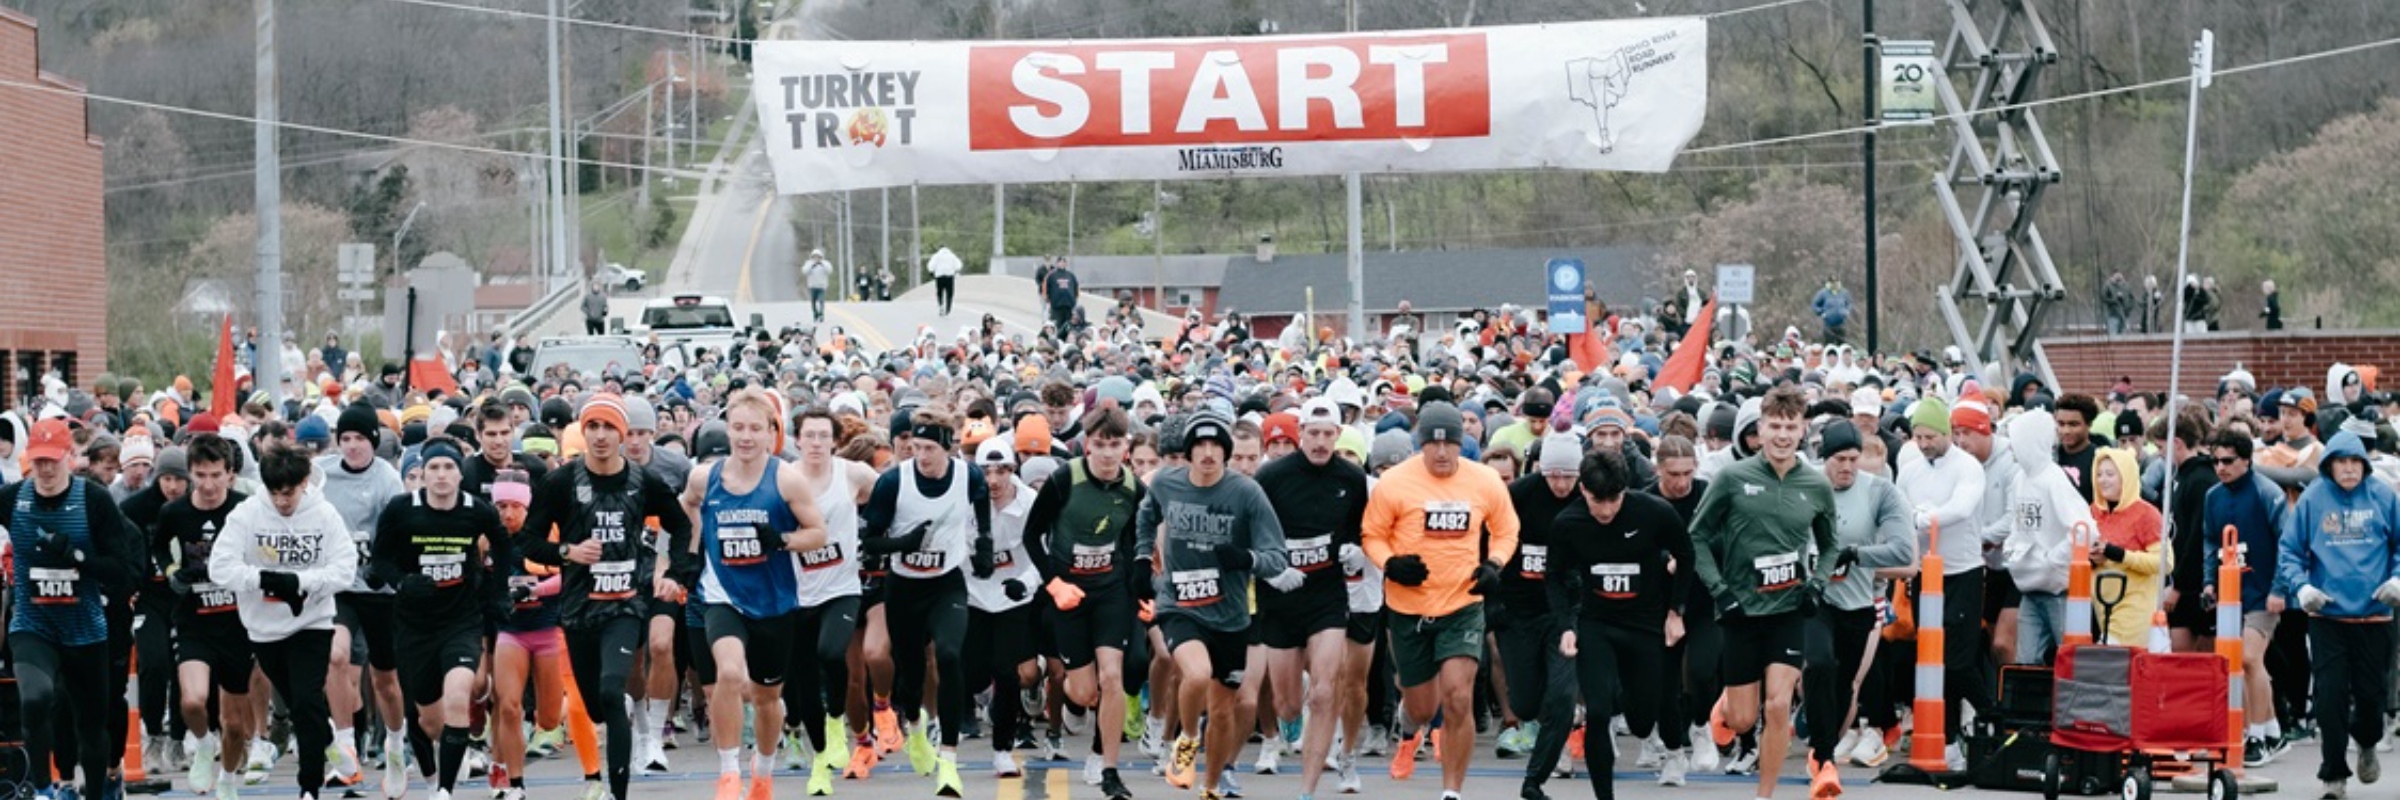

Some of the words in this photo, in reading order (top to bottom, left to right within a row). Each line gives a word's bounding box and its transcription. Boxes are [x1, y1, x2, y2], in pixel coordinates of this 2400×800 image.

[1893, 63, 1924, 82] 20
[780, 71, 921, 110] TURKEY
[1008, 44, 1448, 139] START
[595, 511, 624, 527] THE
[1428, 512, 1468, 530] 4492
[254, 533, 324, 549] TURKEY
[723, 538, 761, 558] 6749
[275, 548, 323, 563] TROT
[1291, 546, 1329, 567] 6755
[593, 573, 632, 592] 7002
[1603, 574, 1630, 592] 871
[1761, 562, 1795, 586] 7091
[36, 581, 73, 597] 1474
[1176, 580, 1219, 600] 2826
